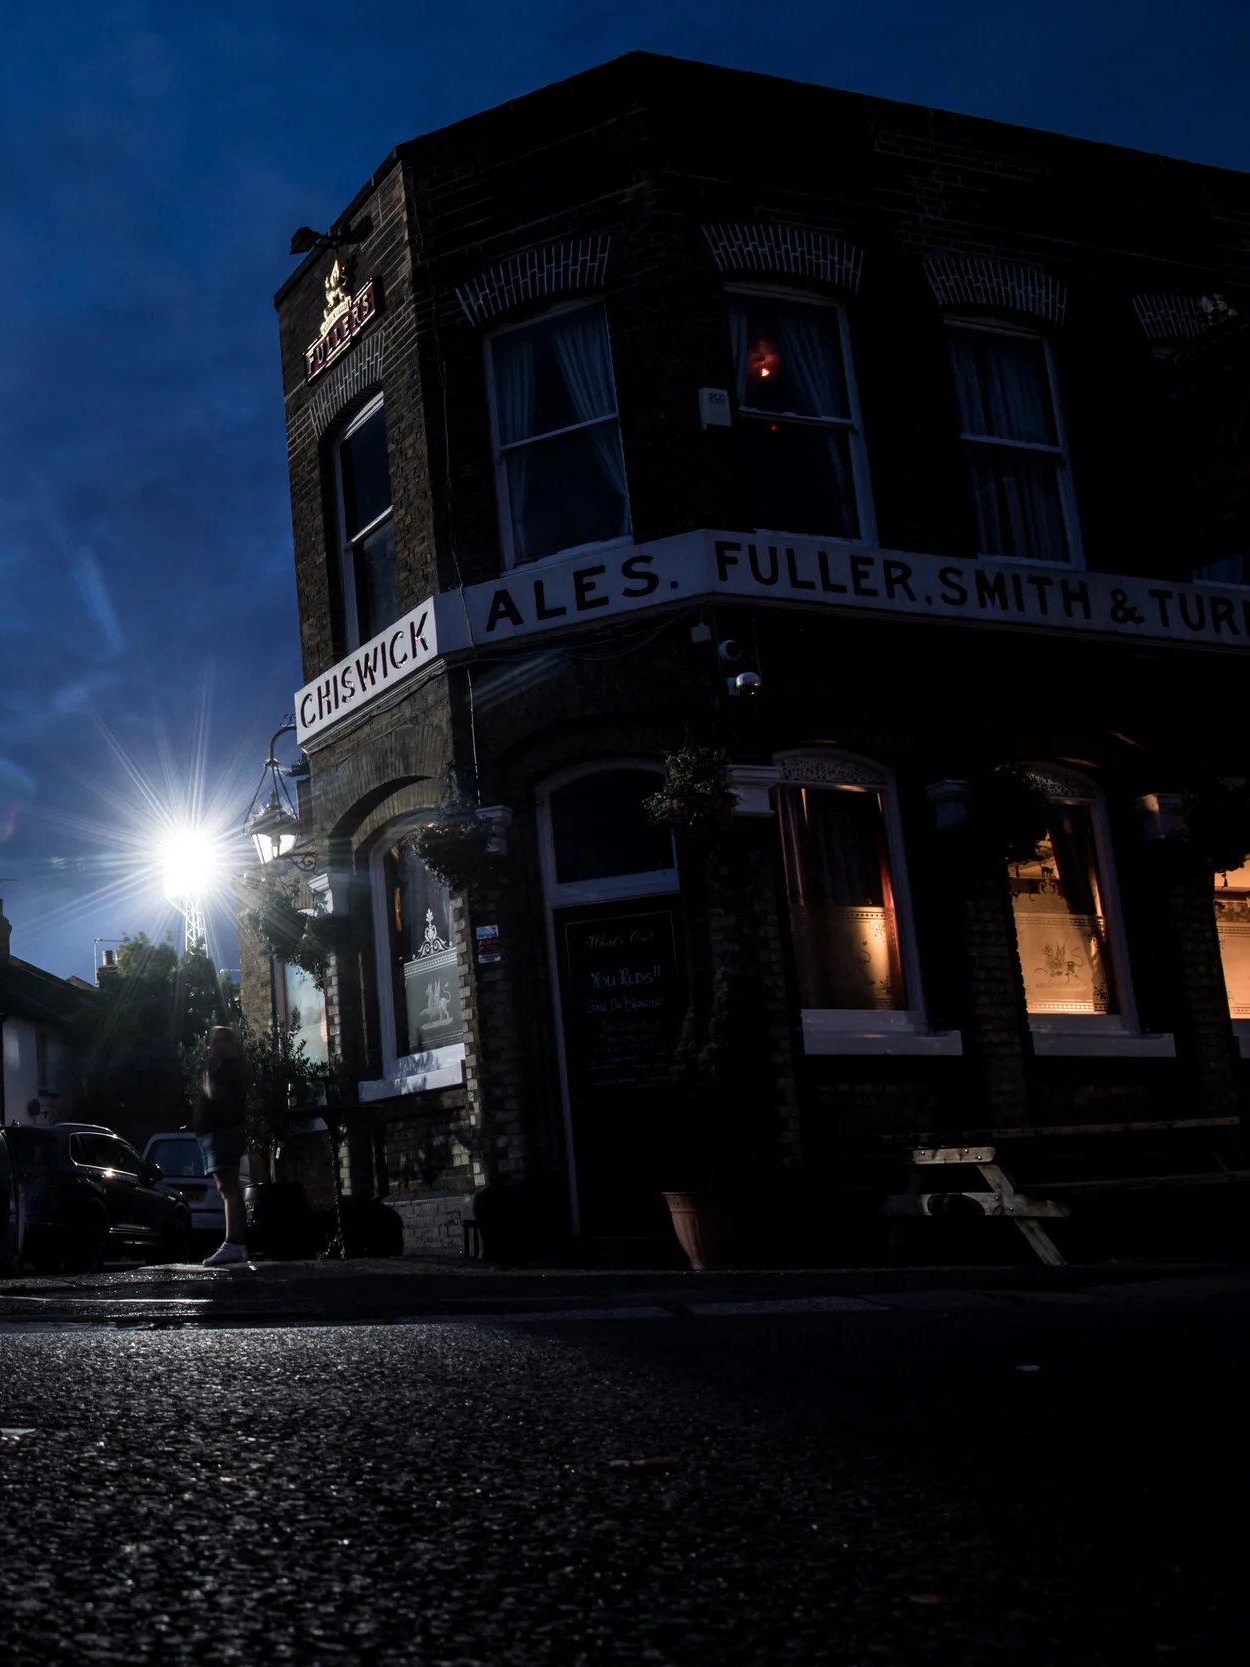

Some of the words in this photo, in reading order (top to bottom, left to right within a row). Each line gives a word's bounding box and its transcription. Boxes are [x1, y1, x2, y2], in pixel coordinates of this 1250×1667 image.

[485, 555, 680, 632] ALES.
[1110, 588, 1145, 625] &
[1148, 590, 1250, 636] TUR
[300, 611, 431, 729] CHISWICK
